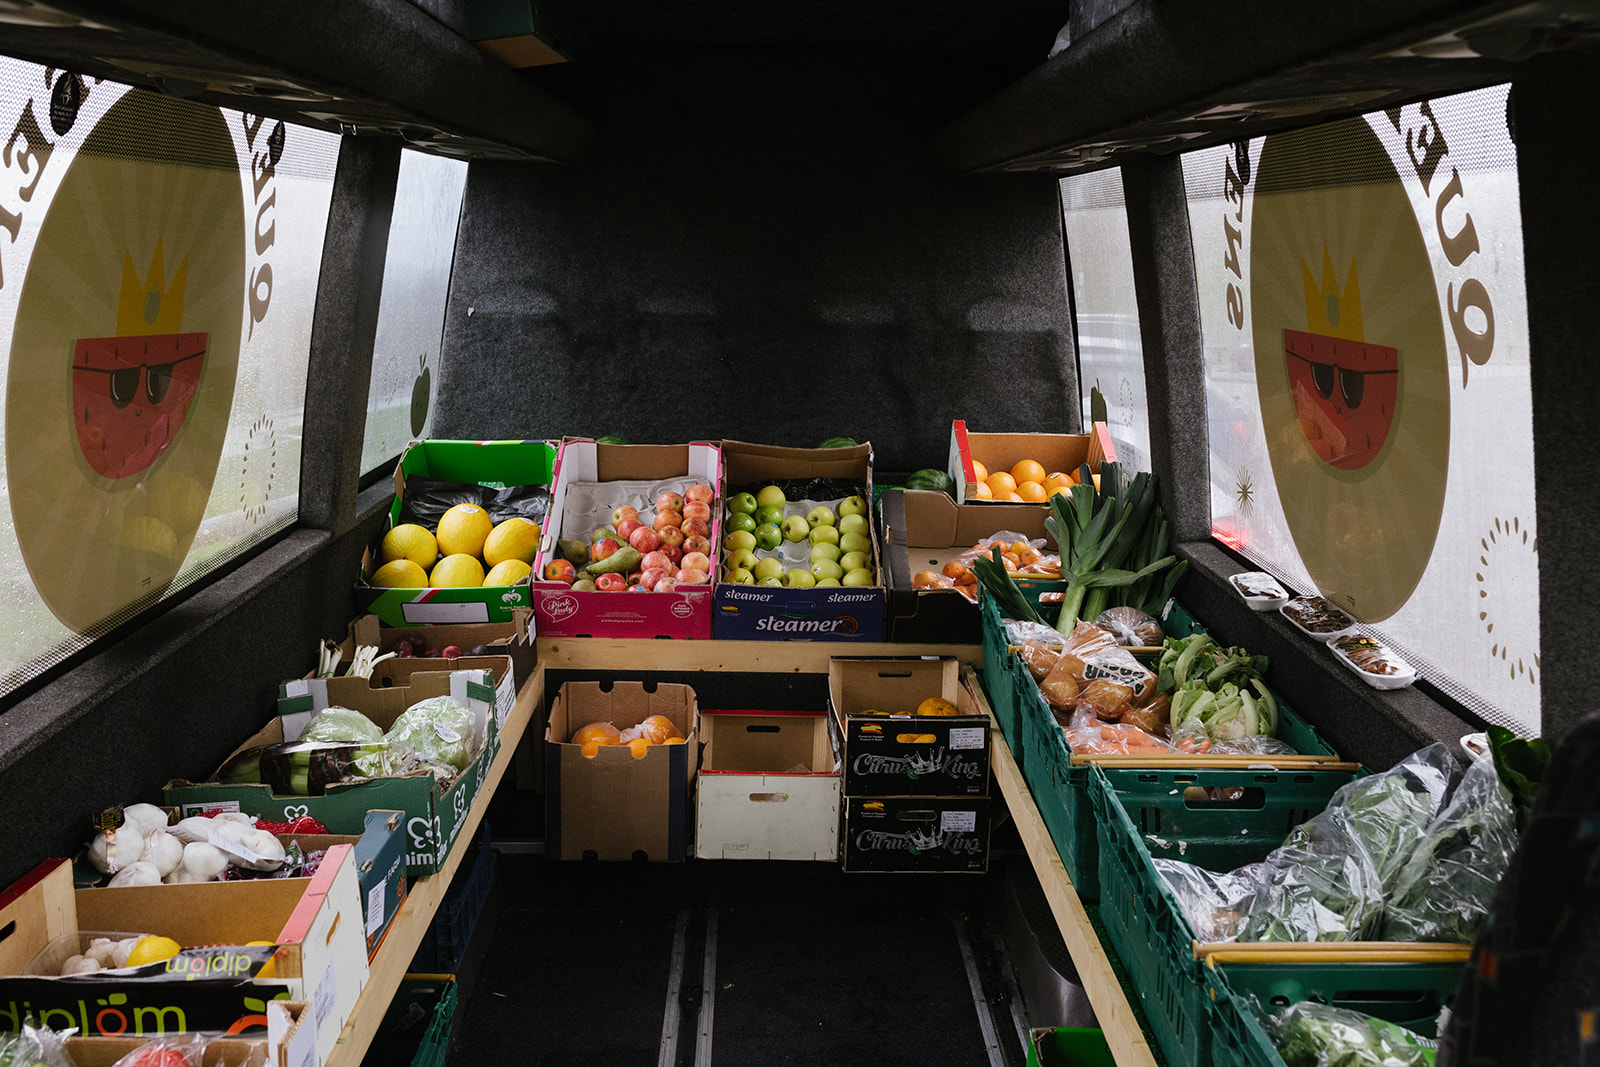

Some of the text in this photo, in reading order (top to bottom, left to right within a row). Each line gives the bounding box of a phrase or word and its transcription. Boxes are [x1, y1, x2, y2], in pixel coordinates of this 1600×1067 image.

[725, 589, 773, 602] steamer
[827, 593, 876, 603] steamer
[547, 598, 571, 610] Pink
[552, 605, 574, 616] Lady
[756, 616, 844, 632] steamer
[853, 753, 982, 779] Citrus King
[856, 829, 983, 855] Citrus King
